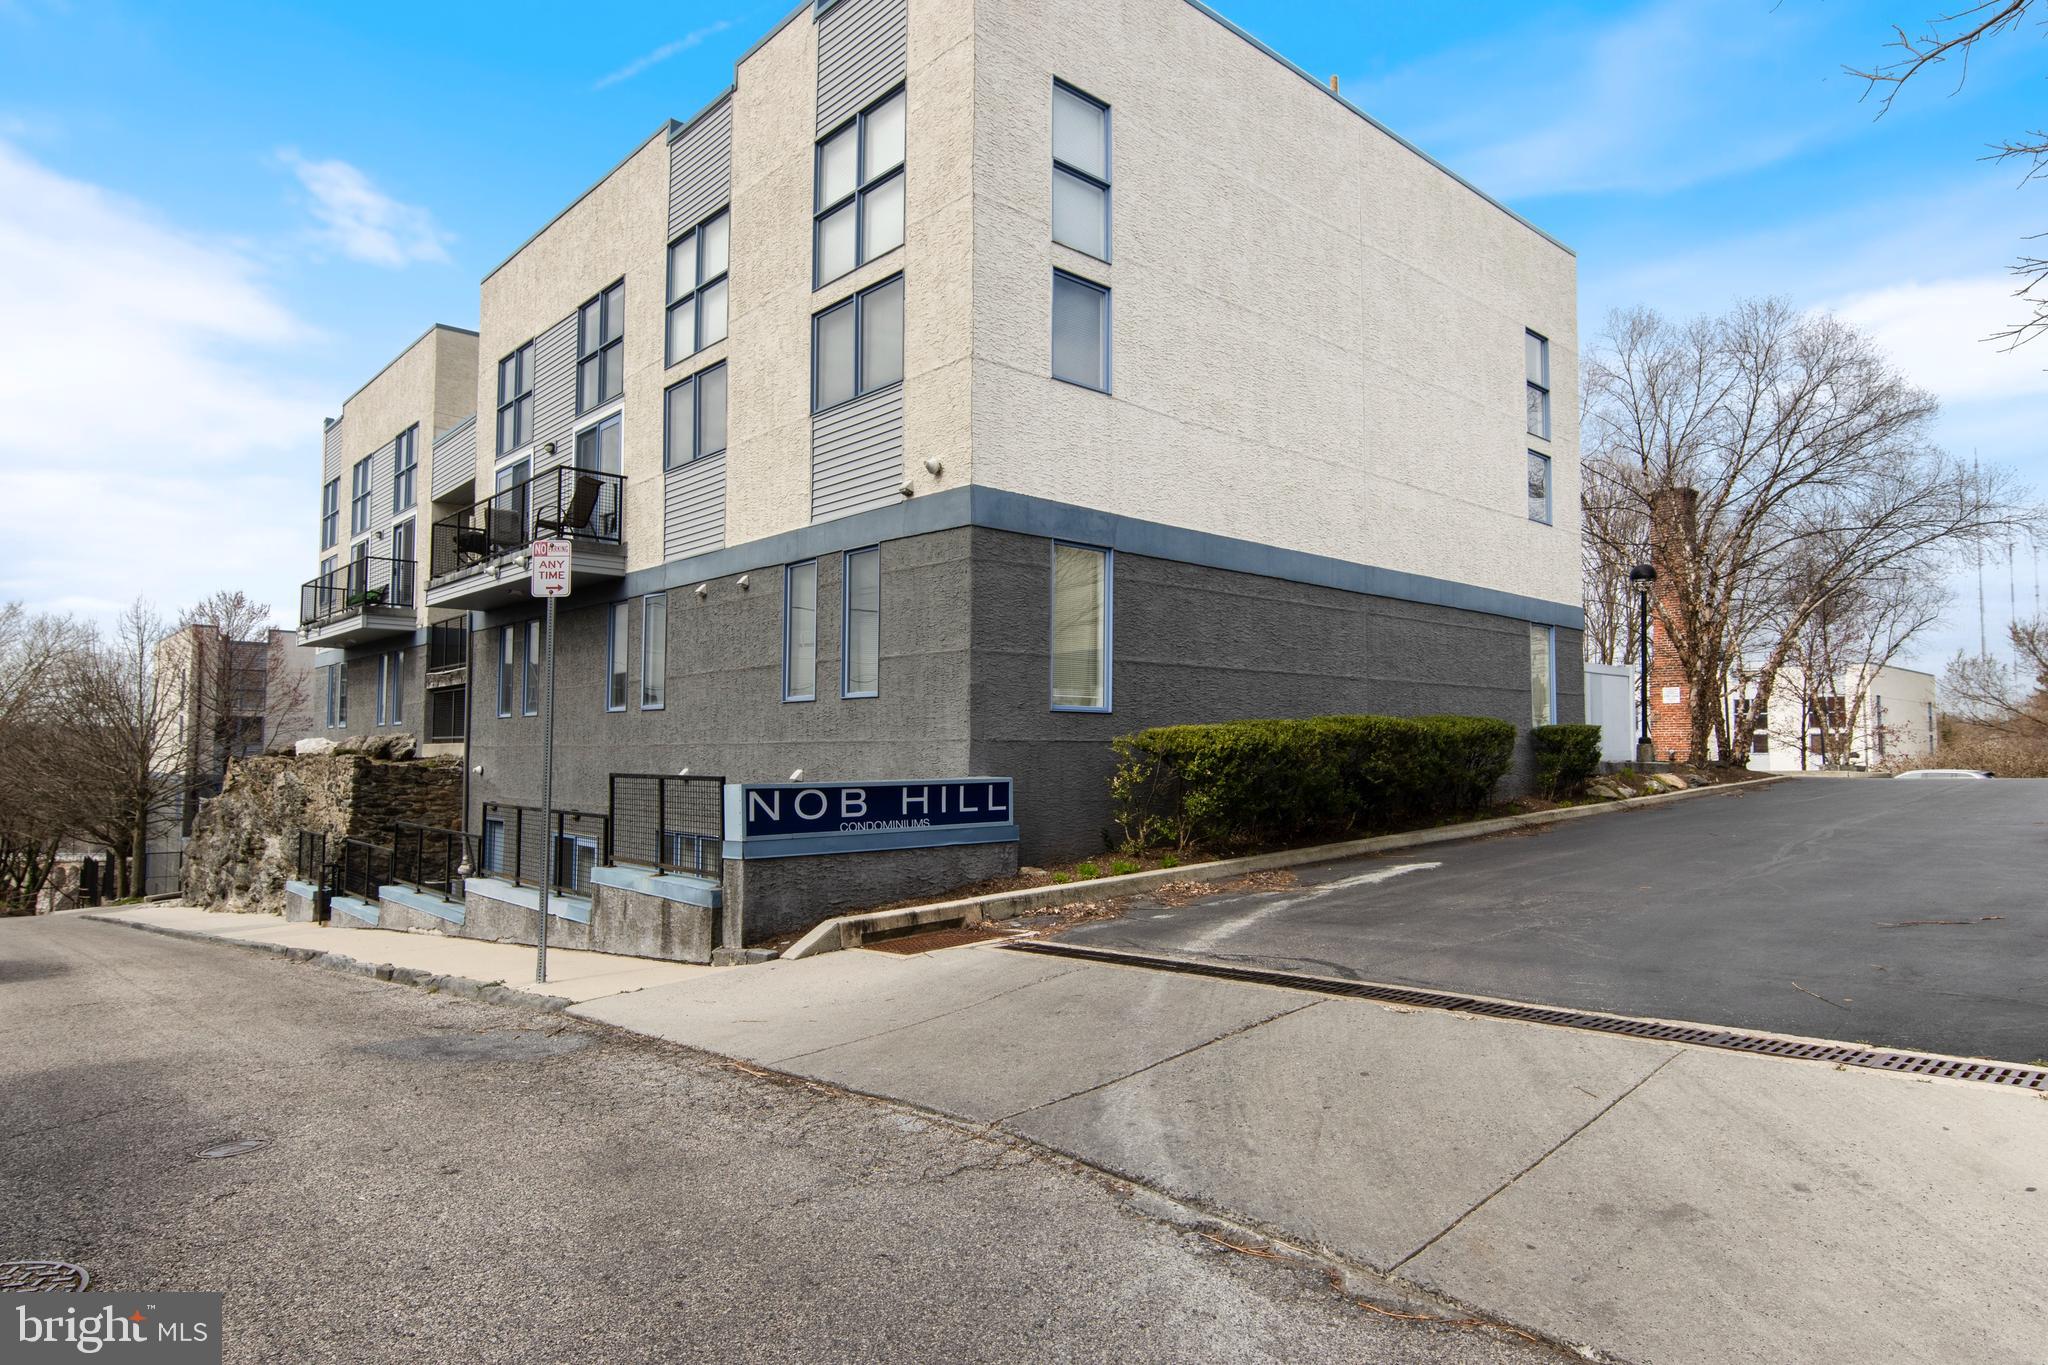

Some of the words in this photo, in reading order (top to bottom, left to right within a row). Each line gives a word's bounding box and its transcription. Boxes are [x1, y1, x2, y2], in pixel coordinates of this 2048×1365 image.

[534, 543, 547, 555] NO
[539, 560, 565, 569] ANY
[539, 571, 565, 580] TIME
[749, 788, 868, 822] NOB
[901, 784, 1007, 815] HILL
[839, 818, 931, 832] CONDOMINIUMS
